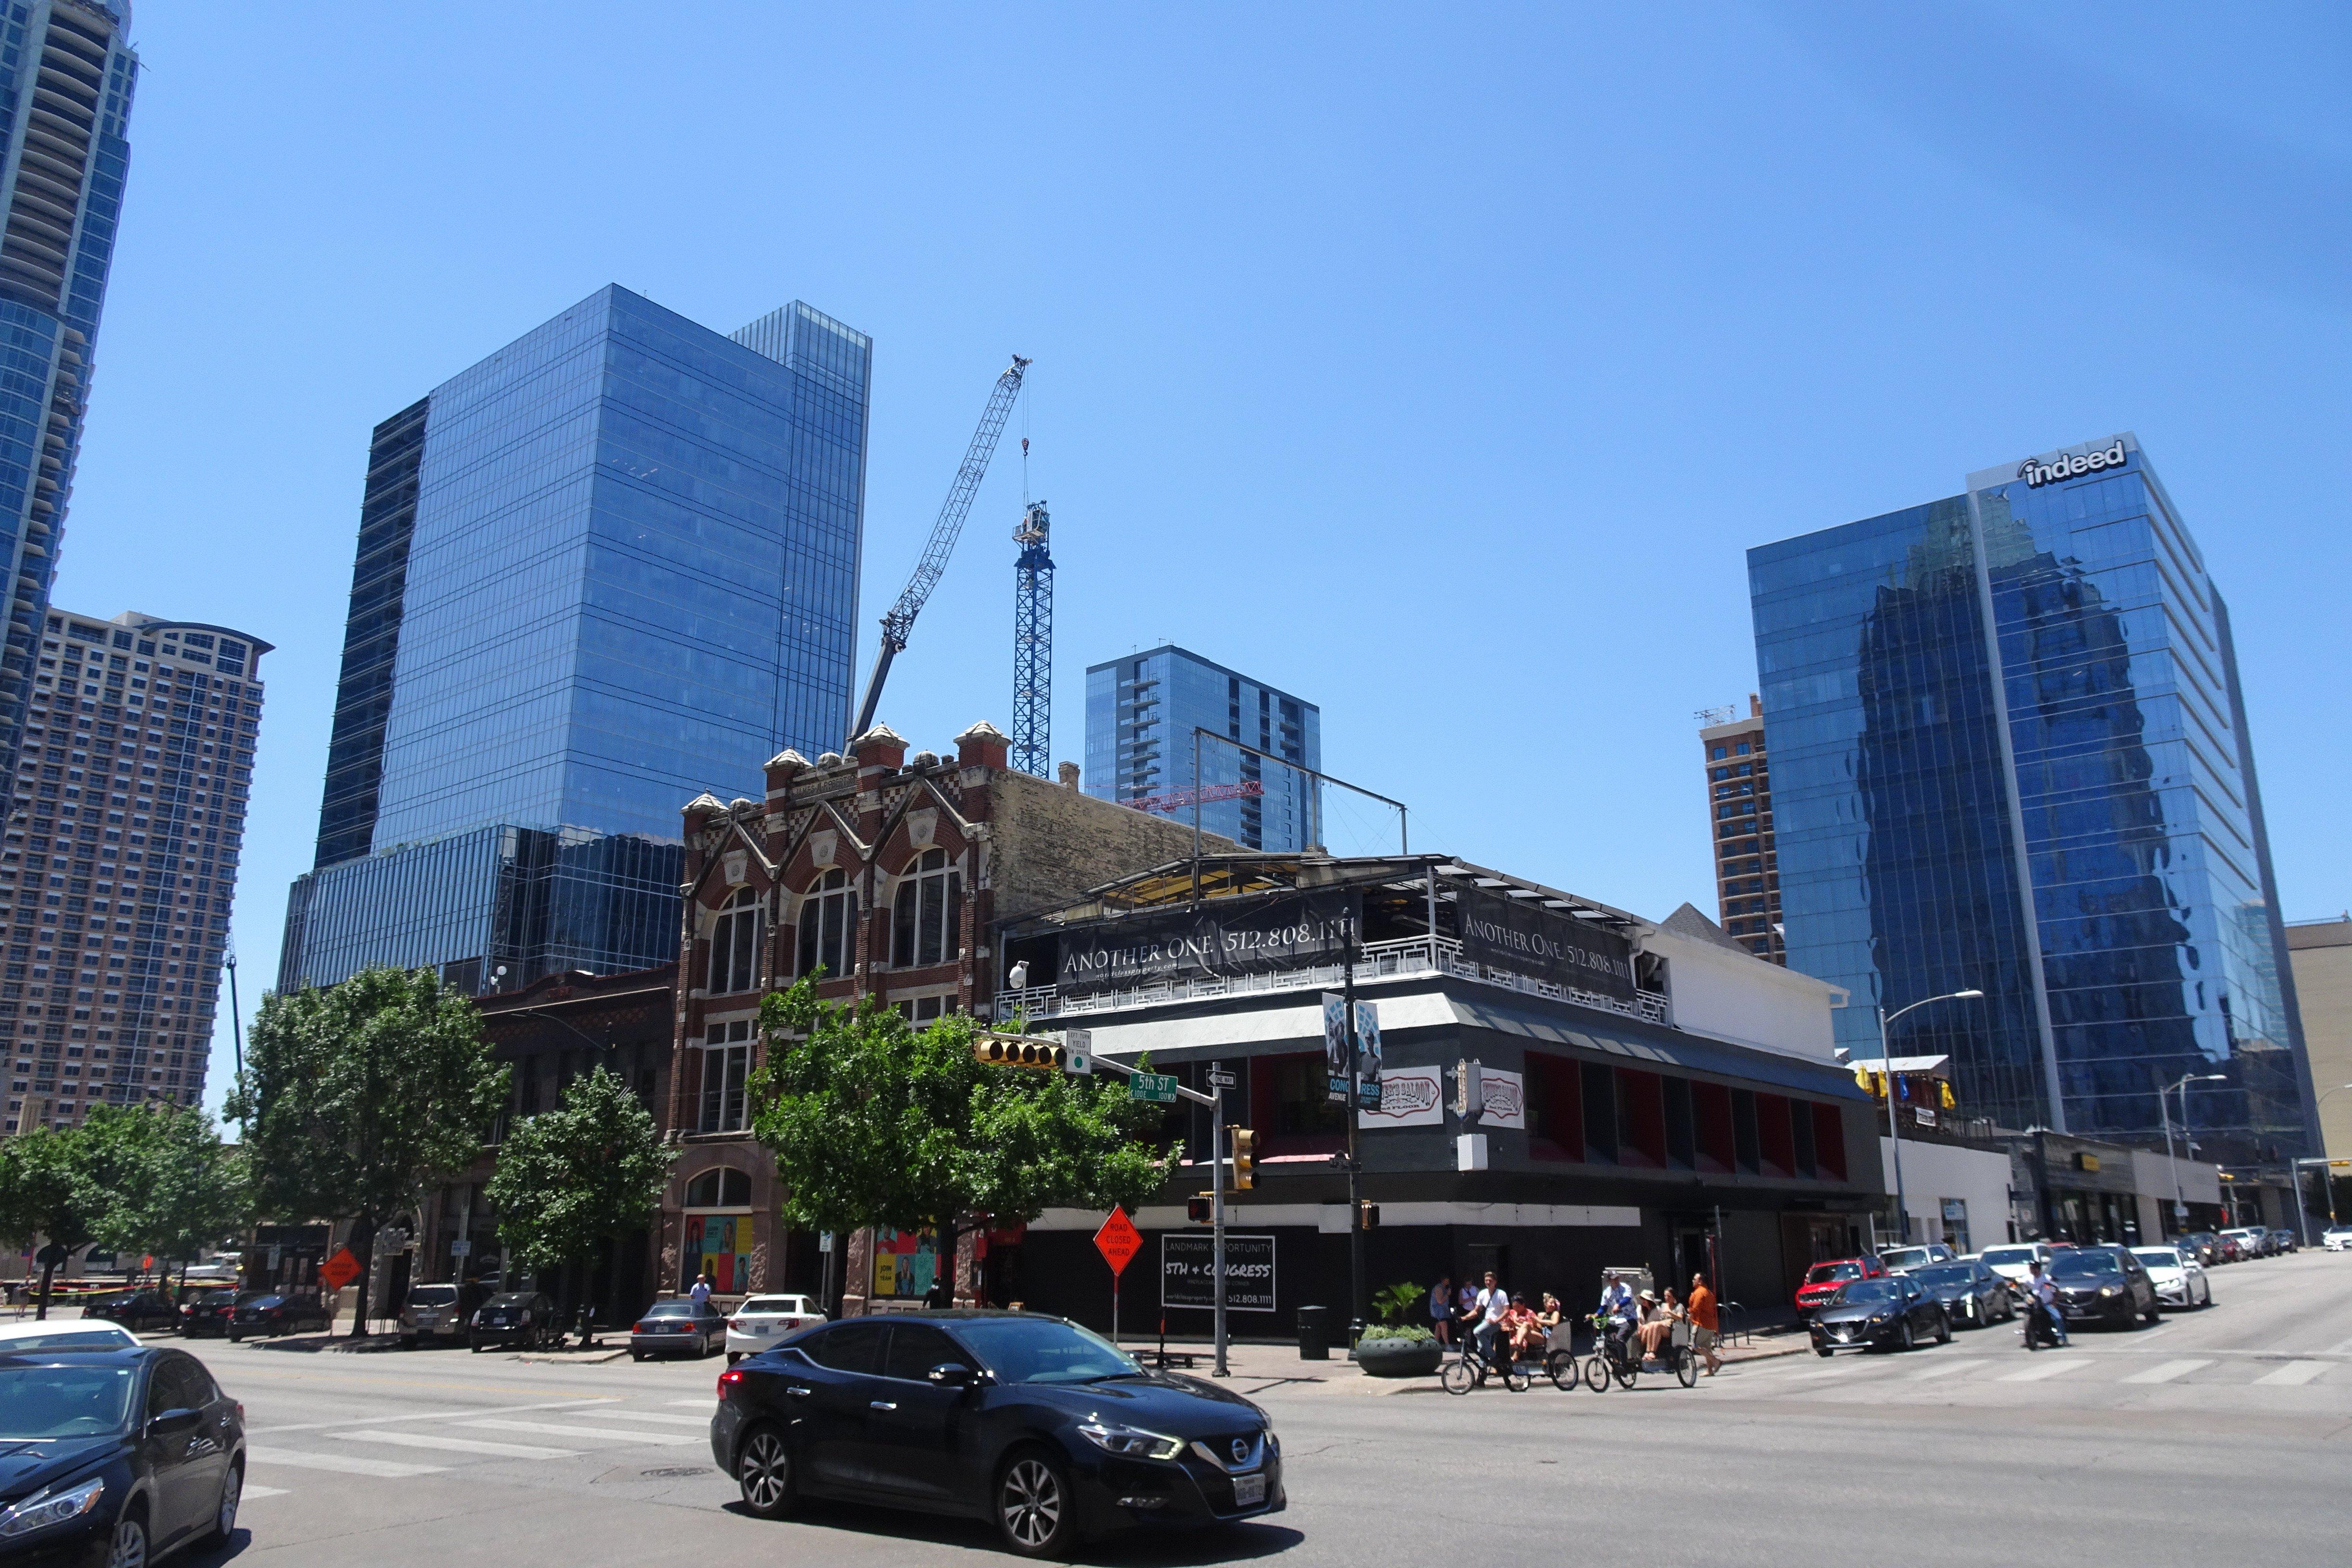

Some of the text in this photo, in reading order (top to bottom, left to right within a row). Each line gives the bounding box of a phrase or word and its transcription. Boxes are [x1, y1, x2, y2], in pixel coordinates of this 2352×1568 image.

[2020, 440, 2126, 488] indeed
[1465, 914, 1531, 952] ANOTHER
[1568, 945, 1630, 979] 512.808.1111
[1063, 944, 1161, 973] ANOTHER
[1072, 1040, 1086, 1048] YIELD
[1139, 1075, 1169, 1091] 5th ST
[1135, 1090, 1172, 1100] 100E 100W
[1328, 1092, 1347, 1102] AVENUE
[1401, 1081, 1431, 1105] SALOON
[1106, 1236, 1131, 1244] CLOSED
[1165, 1242, 1271, 1253] LANDMARK OPORTUNITY
[1165, 1262, 1188, 1275] 5TH
[1228, 1294, 1272, 1304] 512.808.1111
